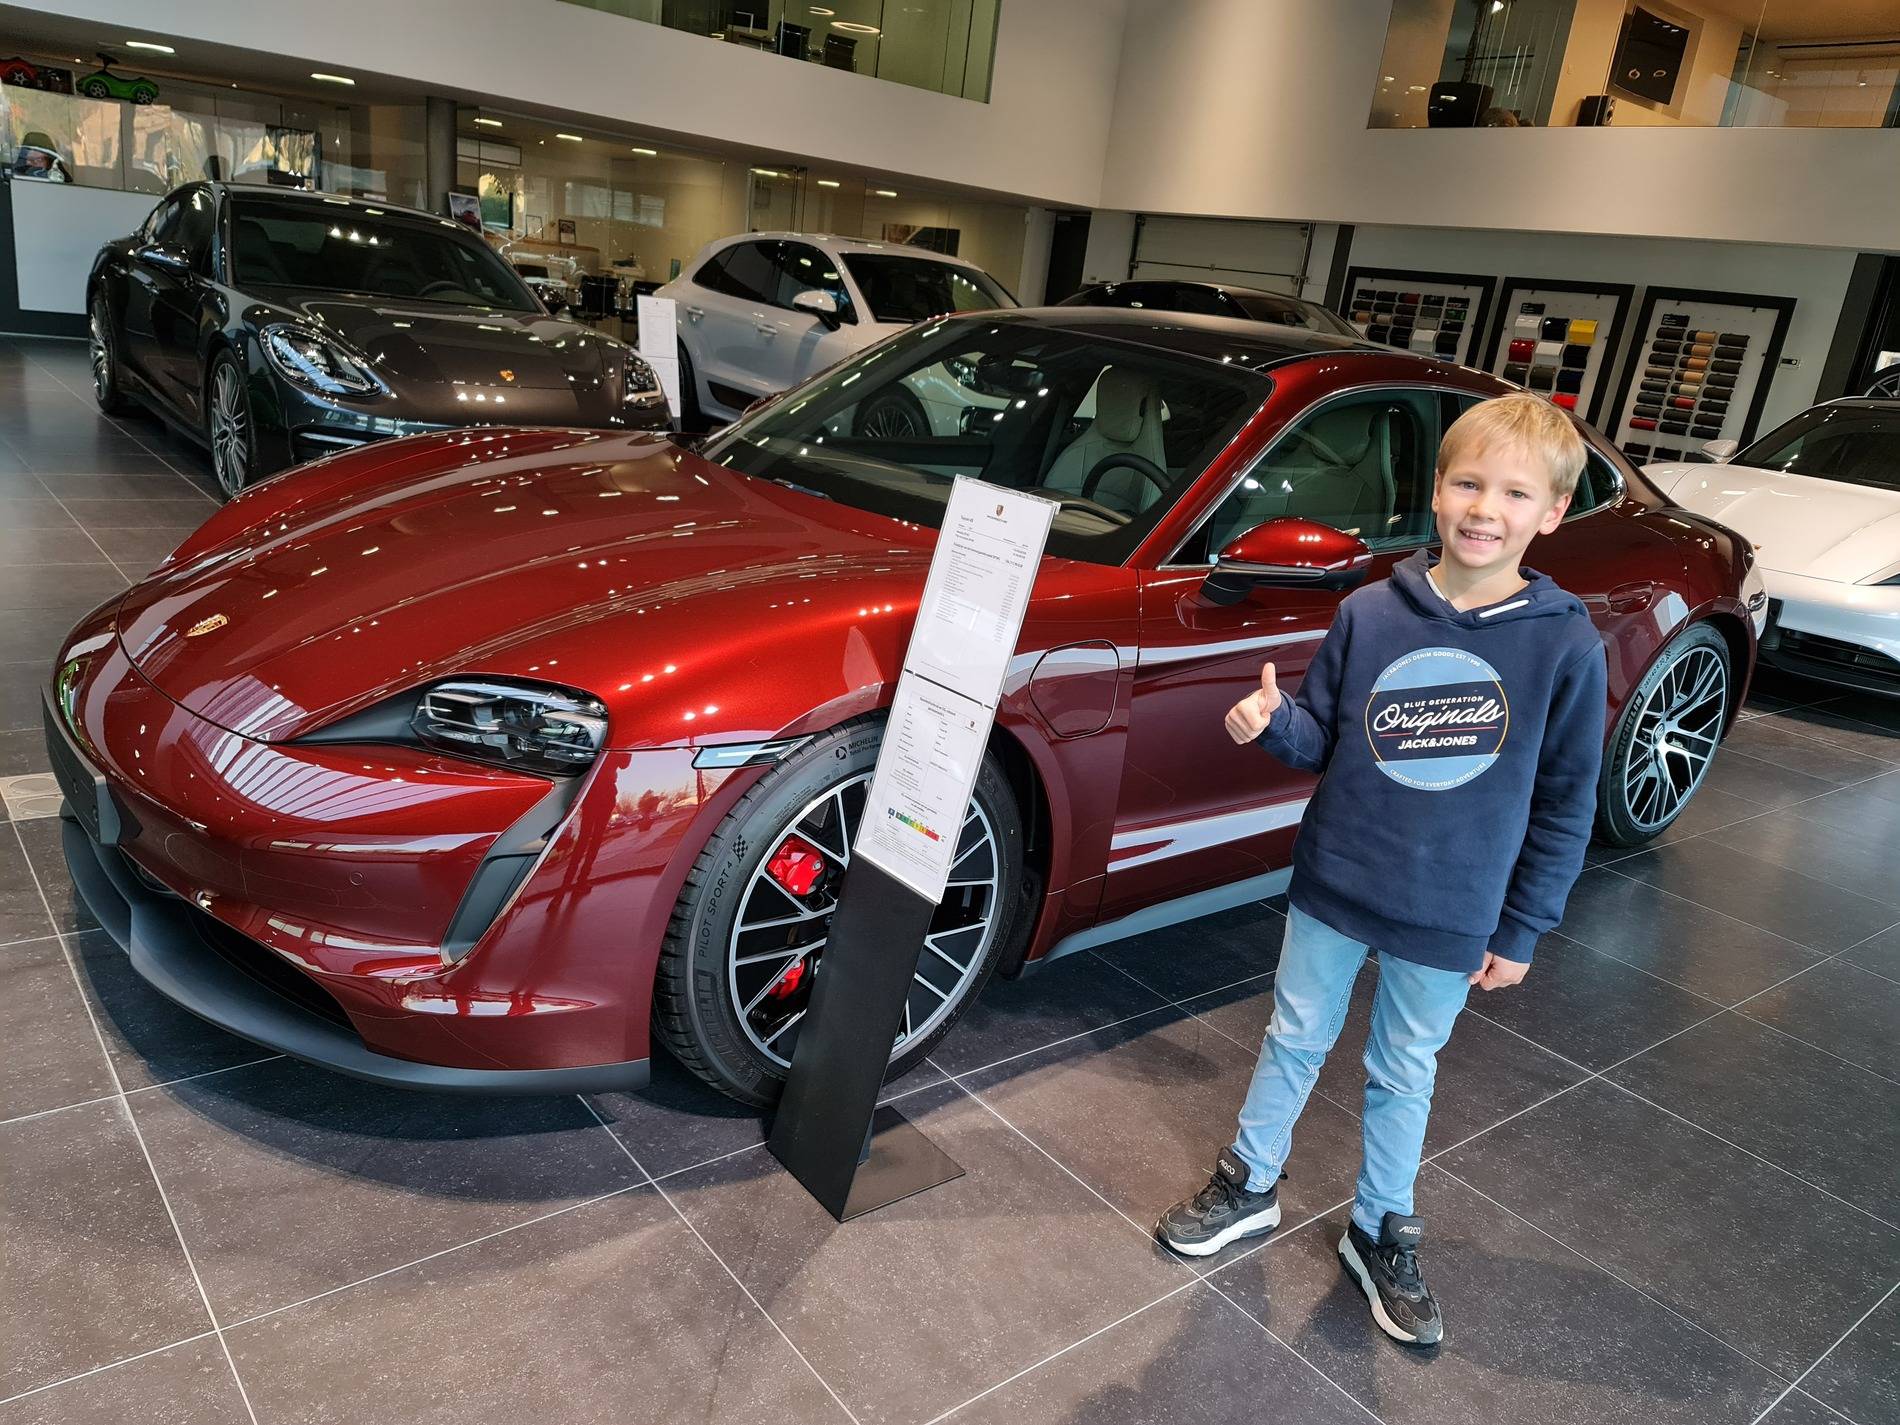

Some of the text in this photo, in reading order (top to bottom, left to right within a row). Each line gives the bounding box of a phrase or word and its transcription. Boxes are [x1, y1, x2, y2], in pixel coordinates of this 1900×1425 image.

[1412, 652, 1432, 661] DENIM
[1456, 652, 1467, 660] EST
[1403, 695, 1484, 709] BLUE GENERATION
[1373, 699, 1505, 735] Originals
[1617, 694, 1644, 757] MICHELIN
[848, 735, 879, 750] MICHELIN
[1398, 735, 1478, 750] JACK&JONES
[1390, 769, 1413, 784] CRAFTED
[698, 919, 712, 958] PILOT
[707, 868, 729, 916] SPORT
